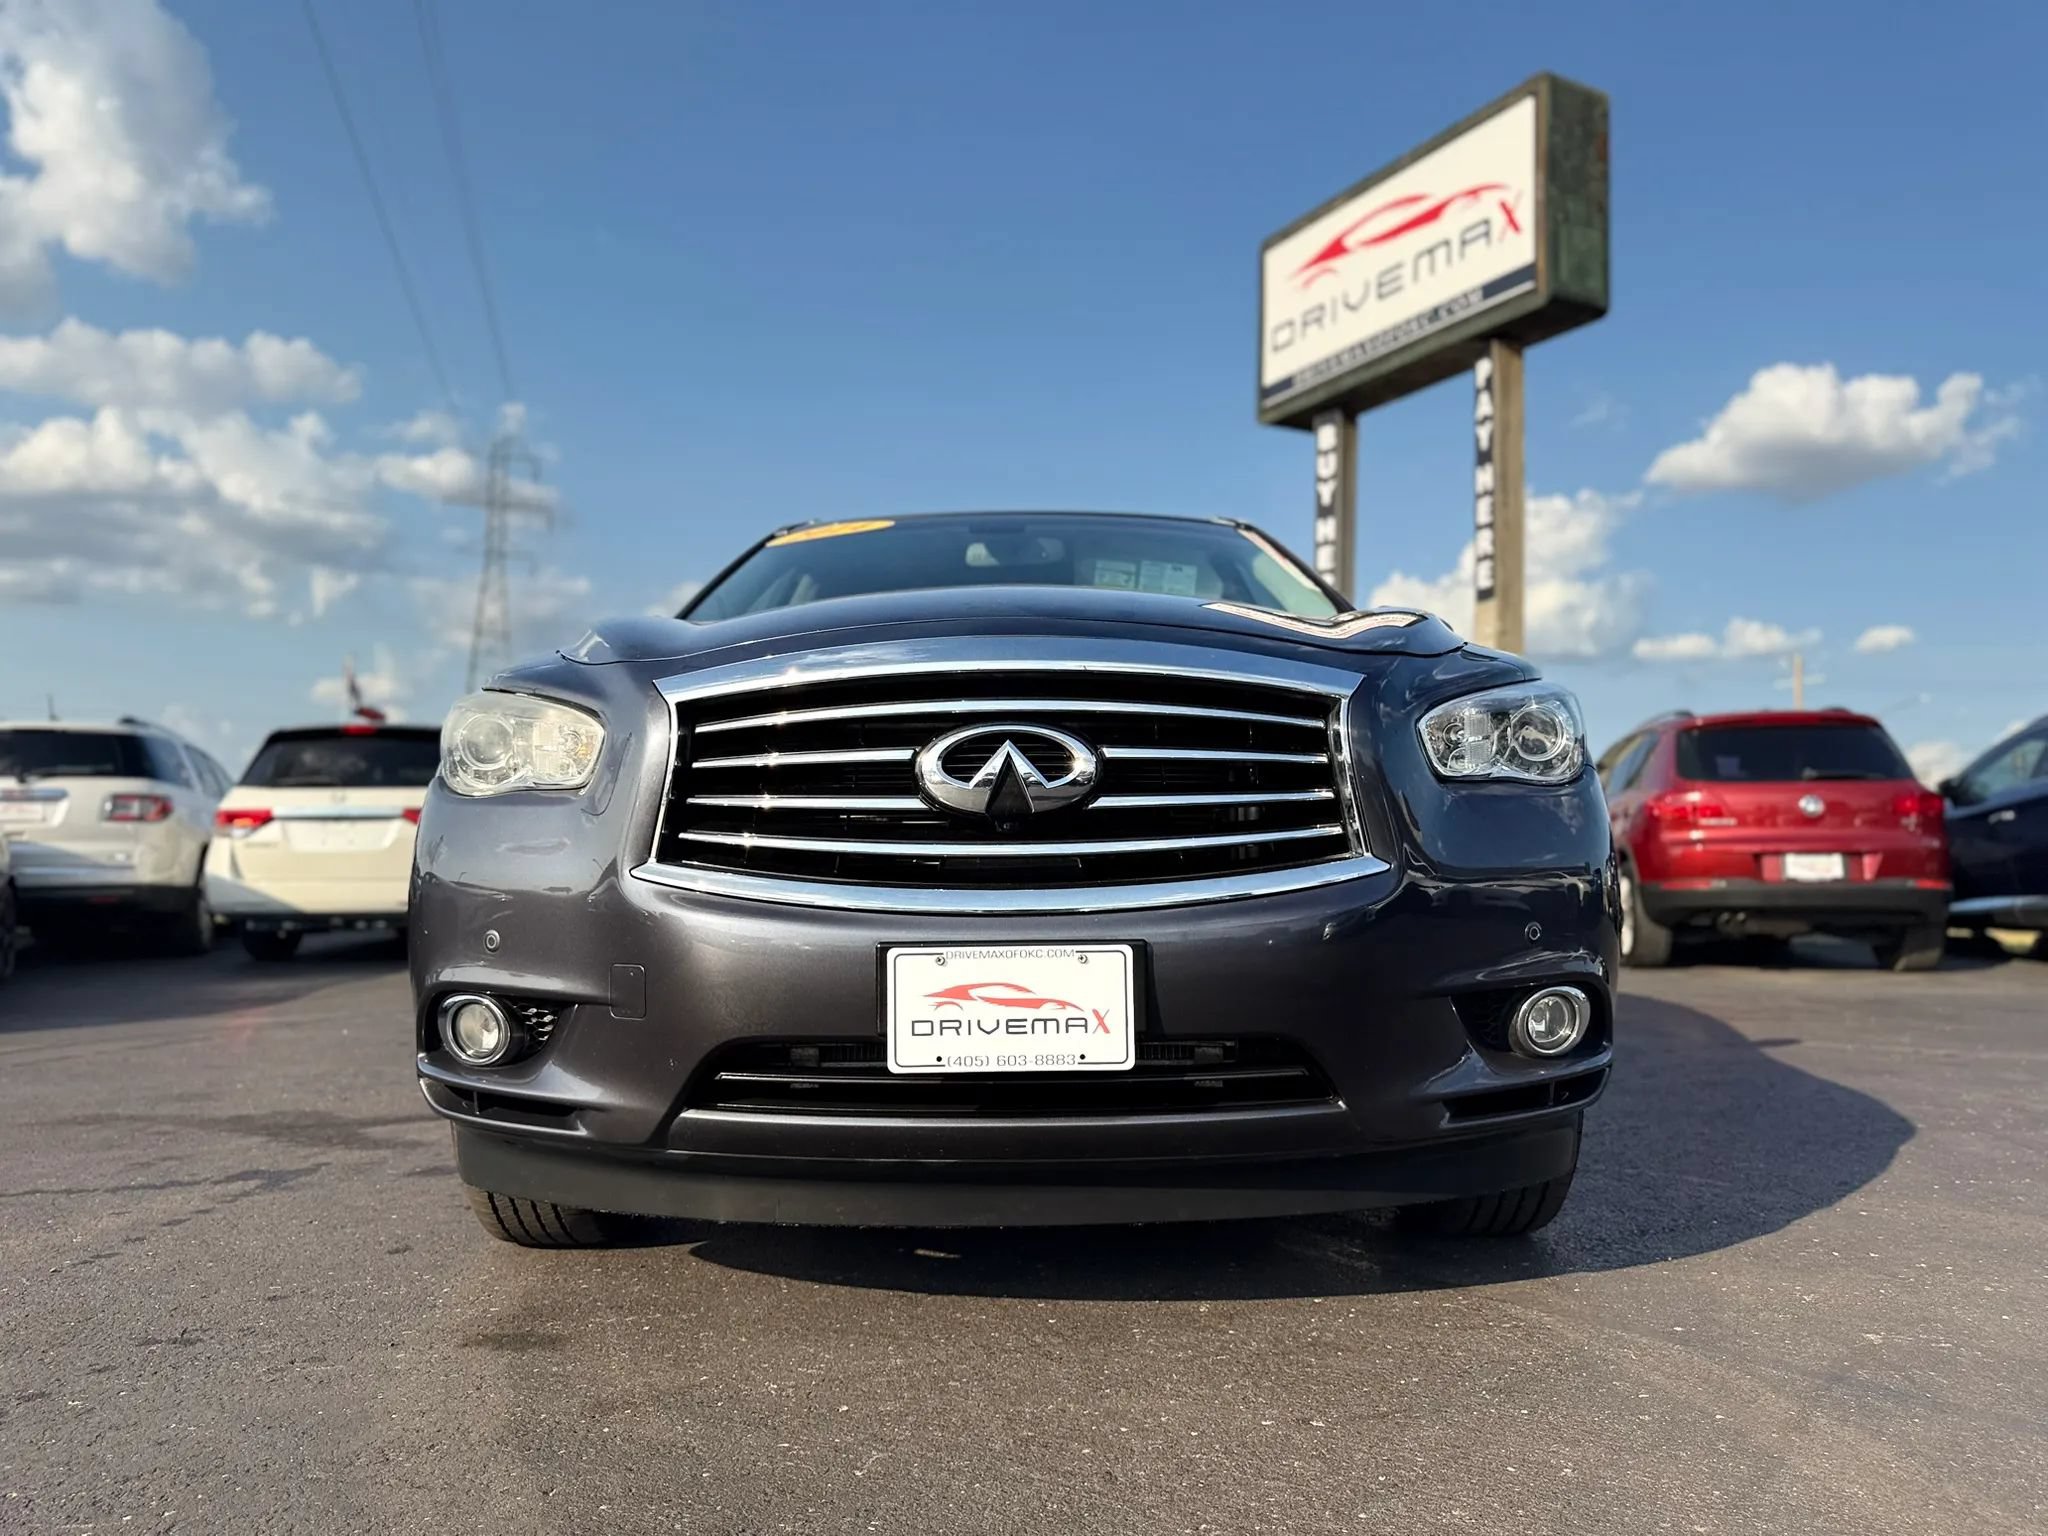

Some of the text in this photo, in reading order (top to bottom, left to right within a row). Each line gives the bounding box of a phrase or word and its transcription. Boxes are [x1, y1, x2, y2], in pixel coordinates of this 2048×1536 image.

[1271, 190, 1523, 354] DRIVEMAX
[945, 948, 1075, 961] DRIVEMAXOFOKC.COM
[911, 1008, 1111, 1037] DRIVEMAX
[947, 1053, 1076, 1068] (405) 603-8883
